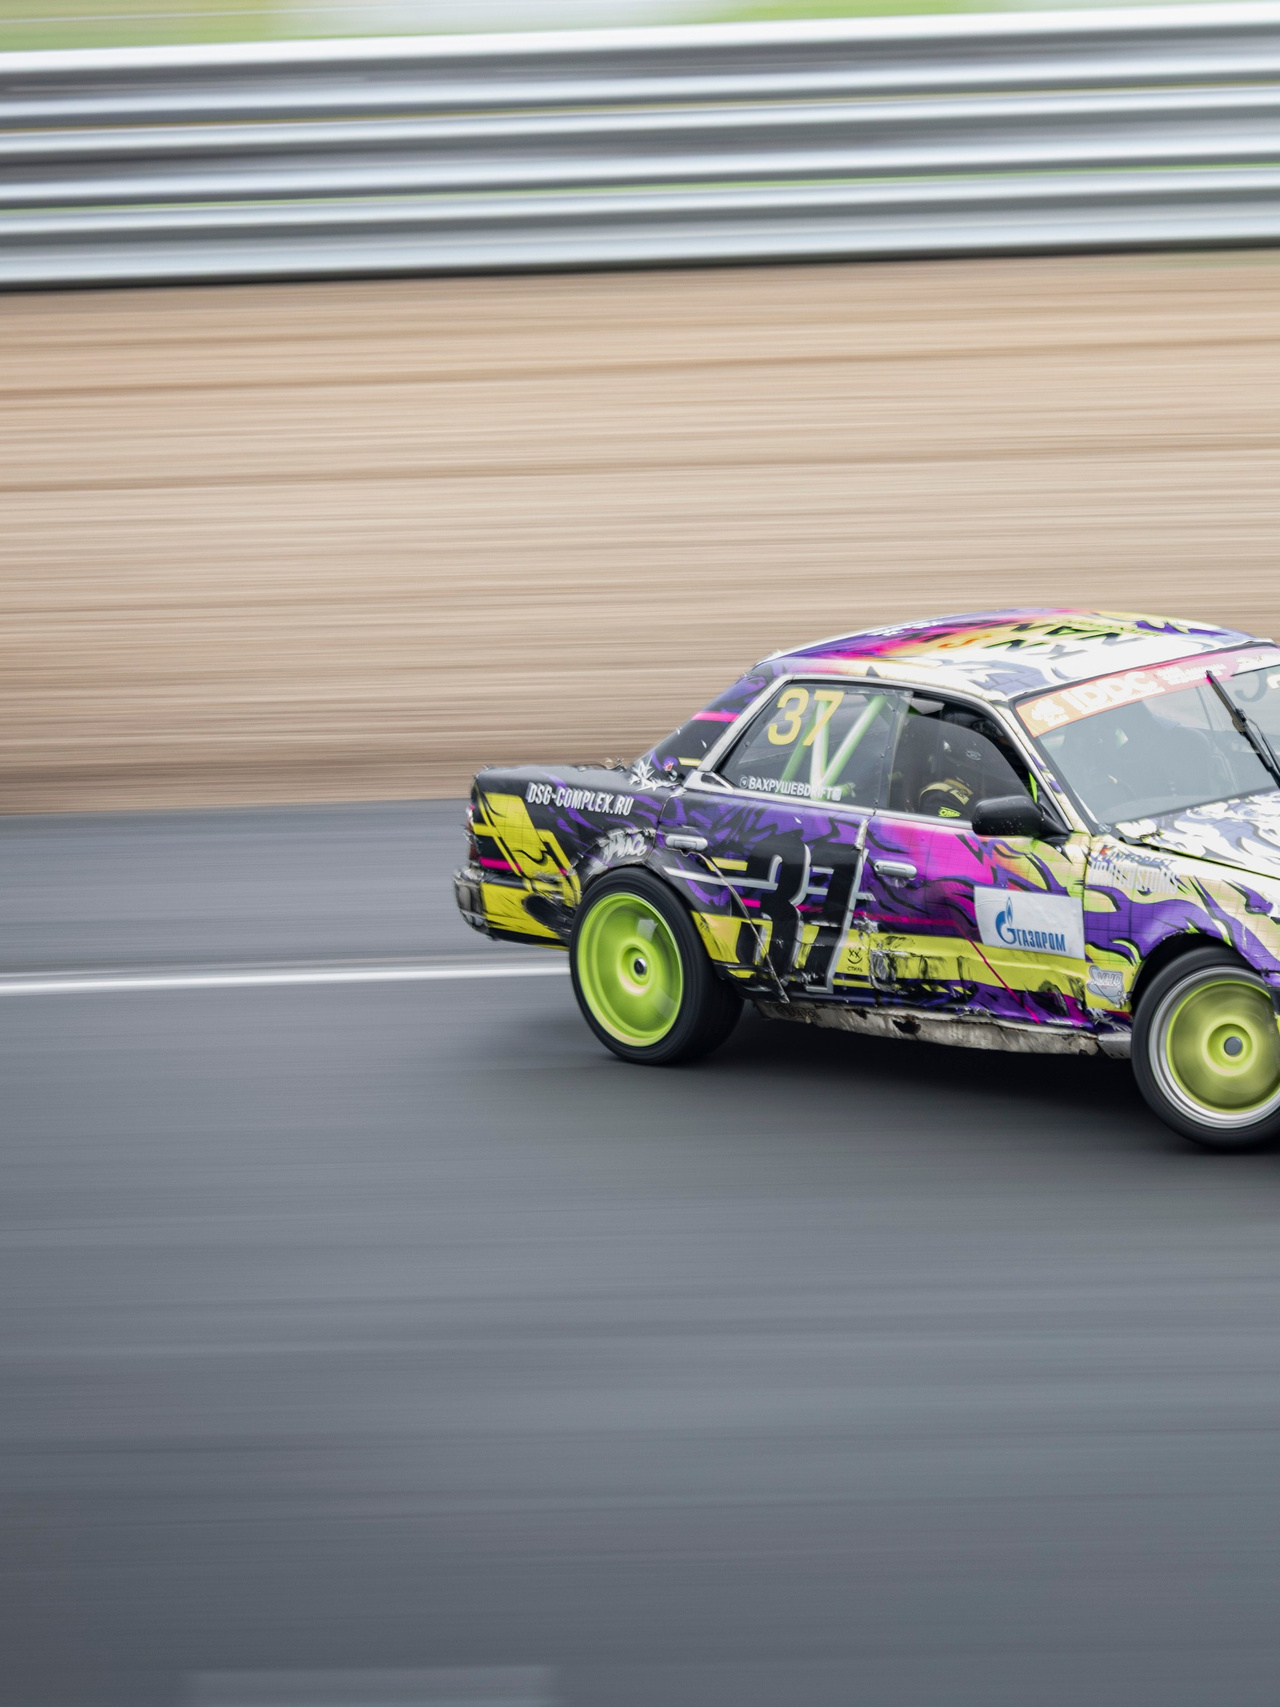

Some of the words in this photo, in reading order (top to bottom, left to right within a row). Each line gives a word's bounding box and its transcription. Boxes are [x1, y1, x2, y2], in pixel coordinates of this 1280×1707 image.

[1060, 671, 1160, 714] IDDC
[768, 687, 845, 747] 37
[525, 782, 635, 816] DSG-COMPLEX.RU
[737, 841, 869, 995] 37
[1016, 928, 1067, 952] ГАЗПРОМ
